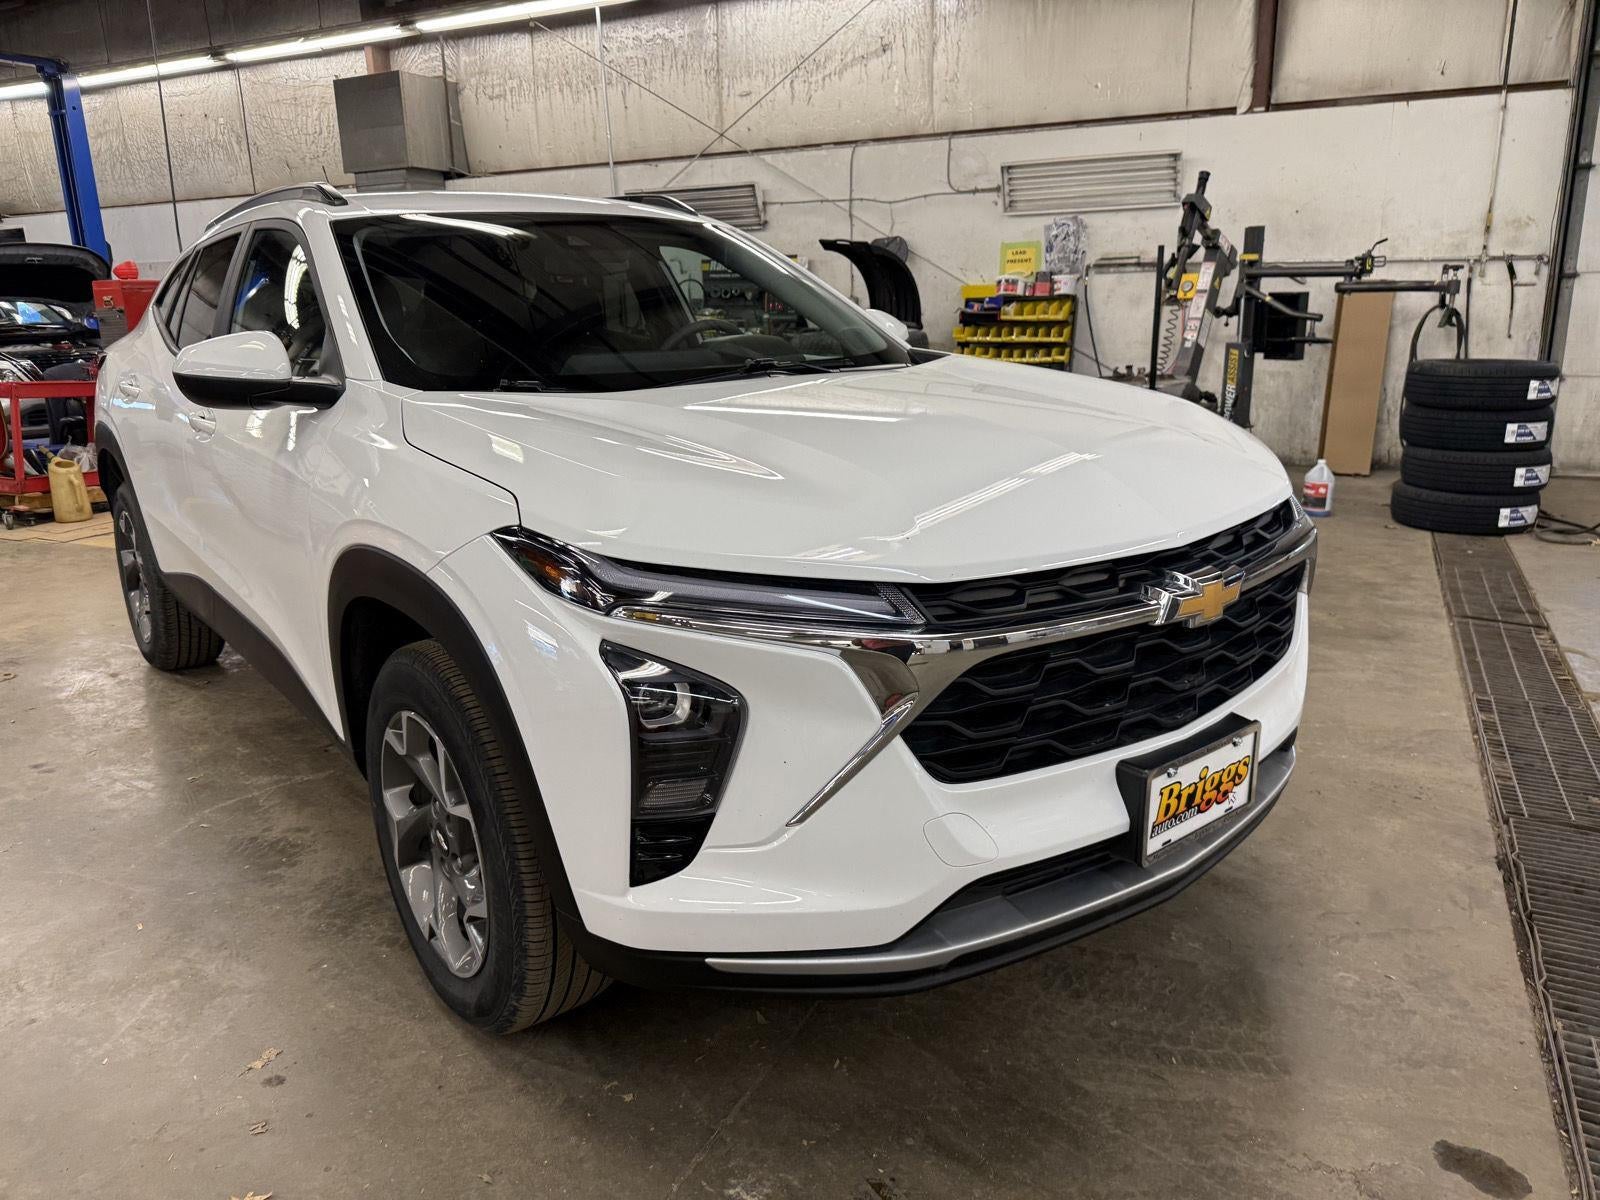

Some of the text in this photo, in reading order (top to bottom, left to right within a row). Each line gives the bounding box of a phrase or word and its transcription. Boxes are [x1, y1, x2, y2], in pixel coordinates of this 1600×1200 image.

[1227, 350, 1239, 384] ASSIST
[1154, 755, 1250, 826] Briggs
[1150, 806, 1199, 838] auto.com
